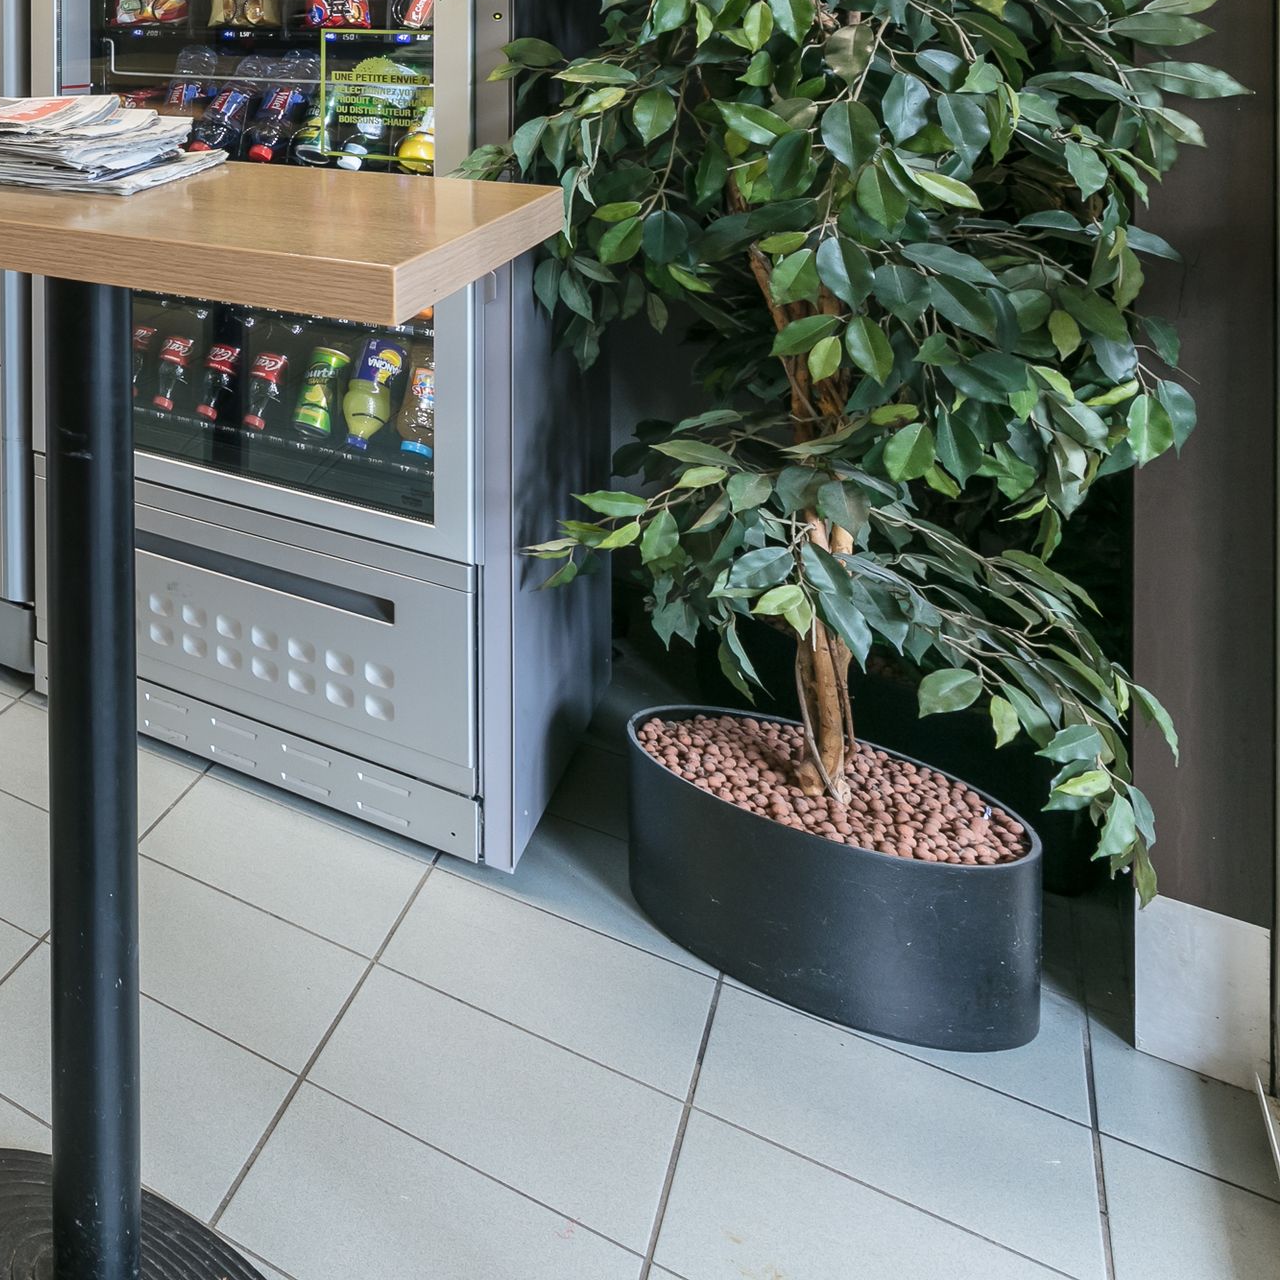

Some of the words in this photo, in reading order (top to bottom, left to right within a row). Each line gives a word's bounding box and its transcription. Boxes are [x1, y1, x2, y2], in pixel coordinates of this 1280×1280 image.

[335, 73, 353, 81] UNE
[355, 73, 388, 82] PETITE
[390, 75, 418, 84] ENVIE
